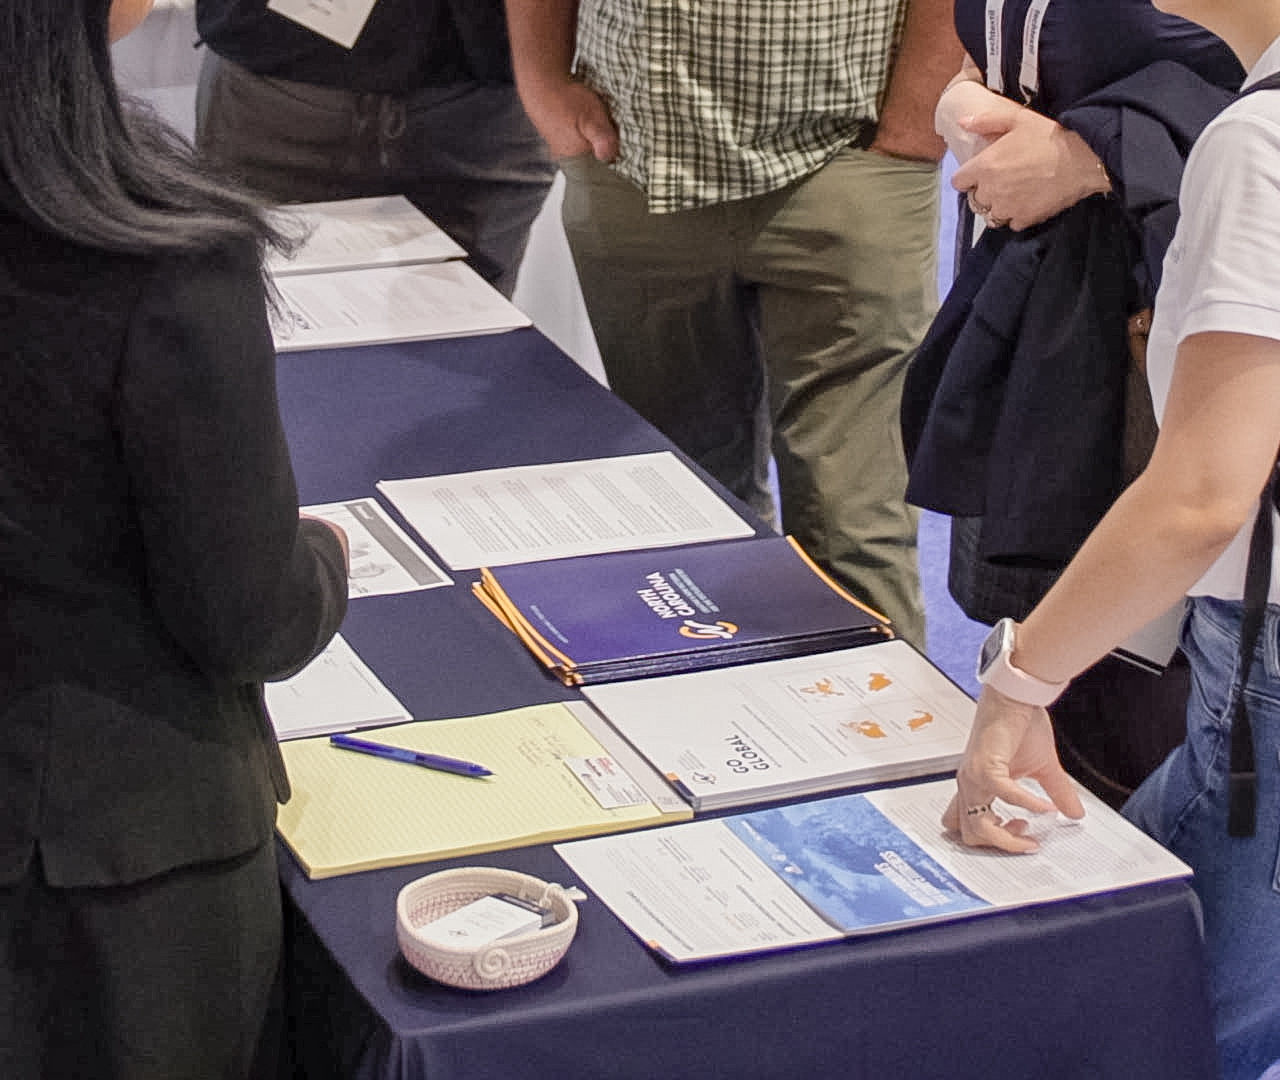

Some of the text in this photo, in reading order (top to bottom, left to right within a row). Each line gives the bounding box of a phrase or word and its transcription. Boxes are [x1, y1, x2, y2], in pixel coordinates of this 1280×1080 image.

[636, 588, 678, 619] NORTH
[645, 571, 696, 617] CAROLINA
[723, 734, 770, 771] GLOBAL
[726, 758, 749, 774] GO
